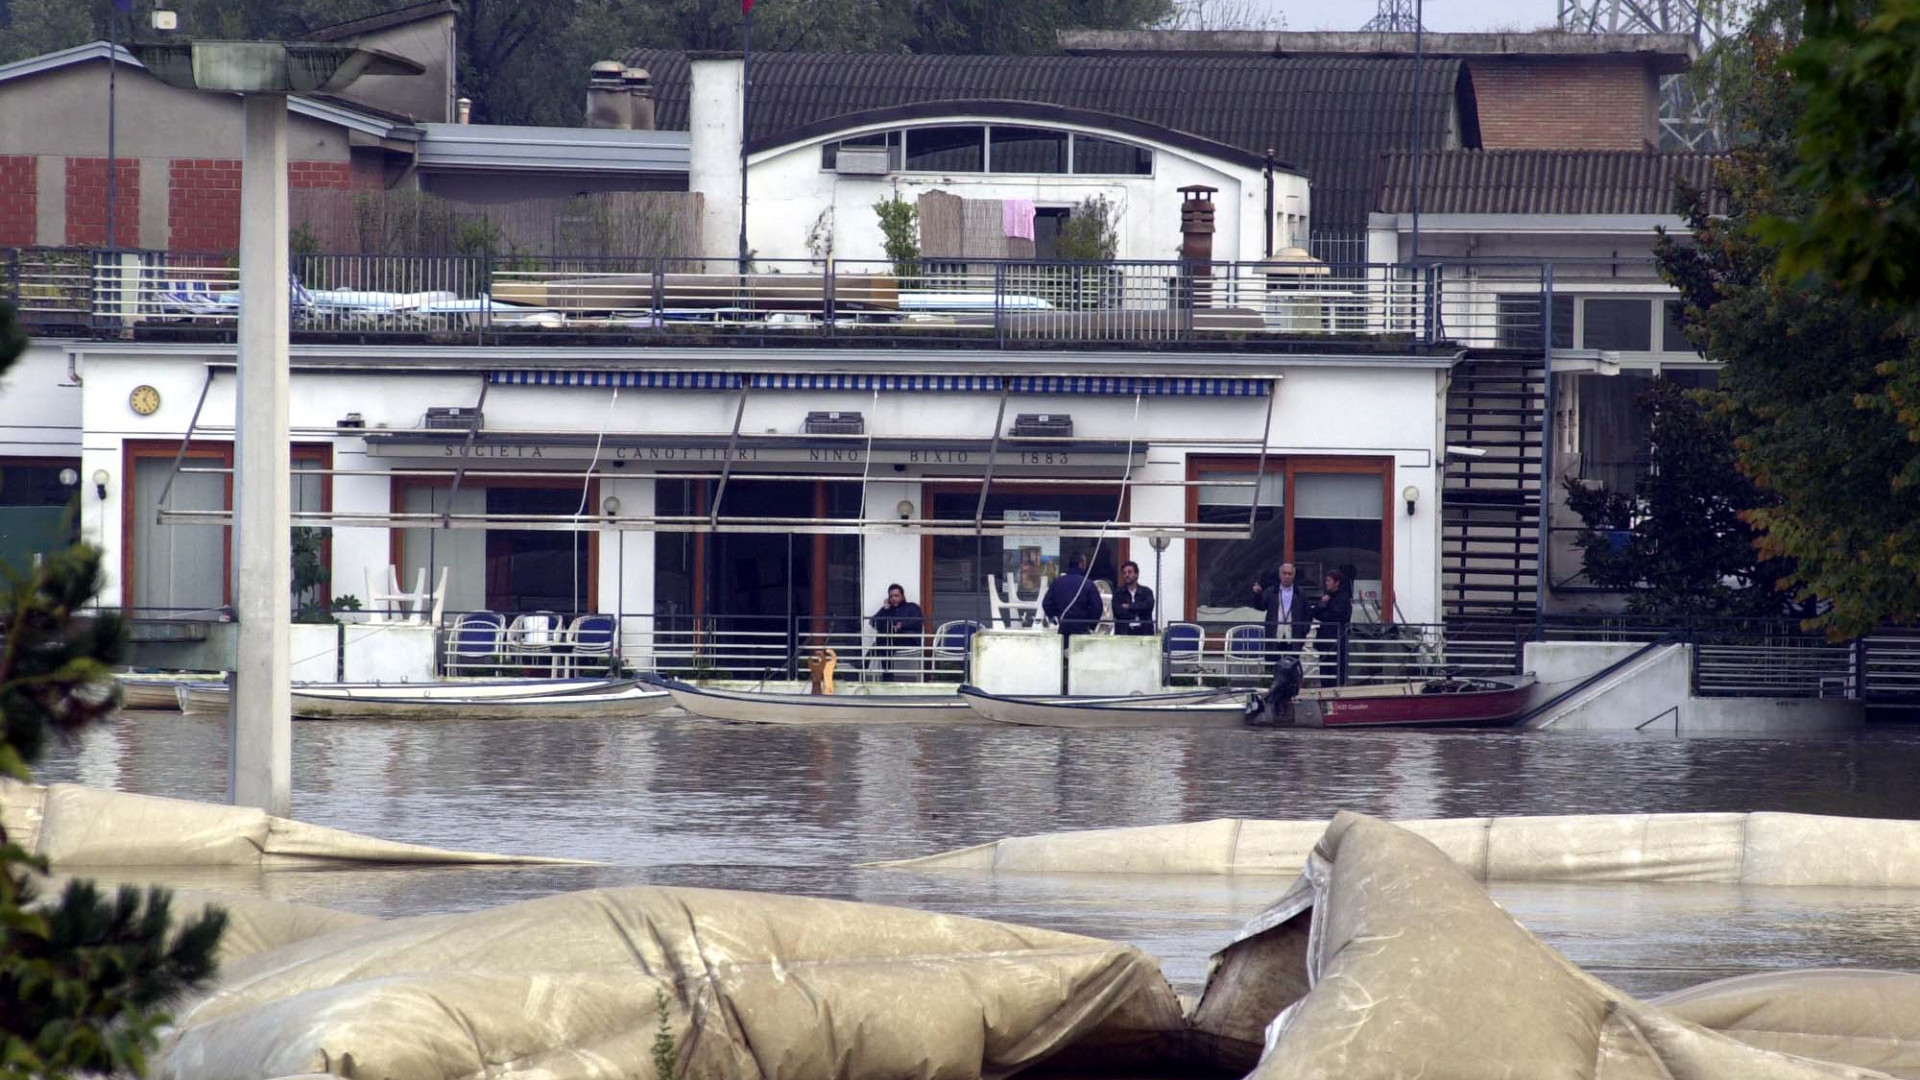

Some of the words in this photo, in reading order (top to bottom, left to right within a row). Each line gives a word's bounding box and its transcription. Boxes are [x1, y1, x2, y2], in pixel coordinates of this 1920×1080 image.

[809, 448, 858, 461] NINO
[910, 450, 968, 462] BIXIO
[1020, 451, 1068, 465] 1883
